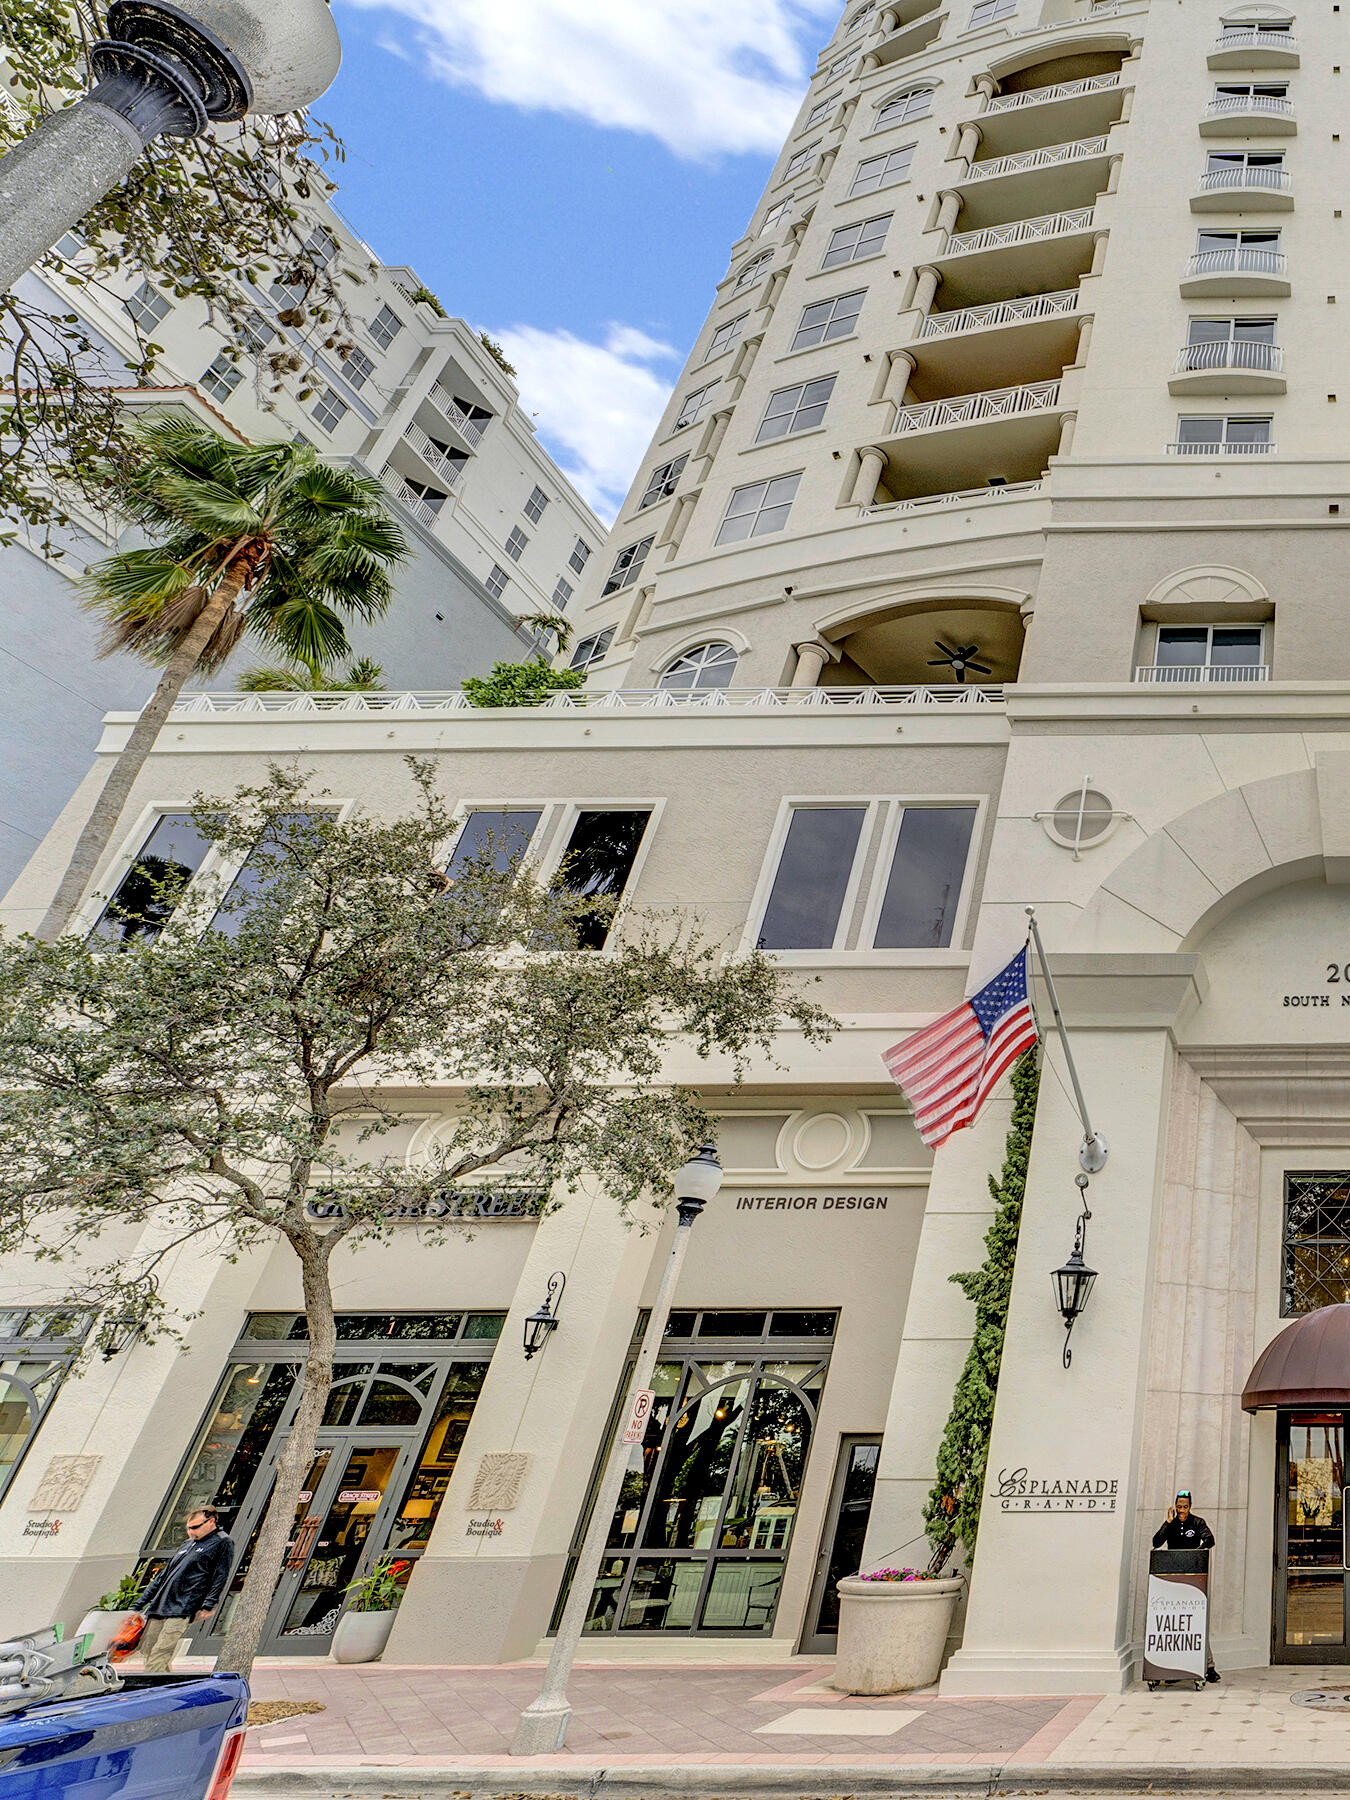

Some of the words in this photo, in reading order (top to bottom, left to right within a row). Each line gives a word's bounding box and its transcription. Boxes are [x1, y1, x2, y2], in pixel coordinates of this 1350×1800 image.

[1283, 995, 1330, 1007] SOUTH
[736, 1197, 818, 1210] INTERIOR
[822, 1197, 888, 1210] DESIGN
[631, 1420, 643, 1430] NO
[990, 1467, 1118, 1498] ESPLANADE
[22, 1528, 59, 1539] Boutique
[466, 1527, 503, 1538] Boutique
[1156, 1614, 1193, 1632] VALET
[1148, 1634, 1202, 1652] PARKING
